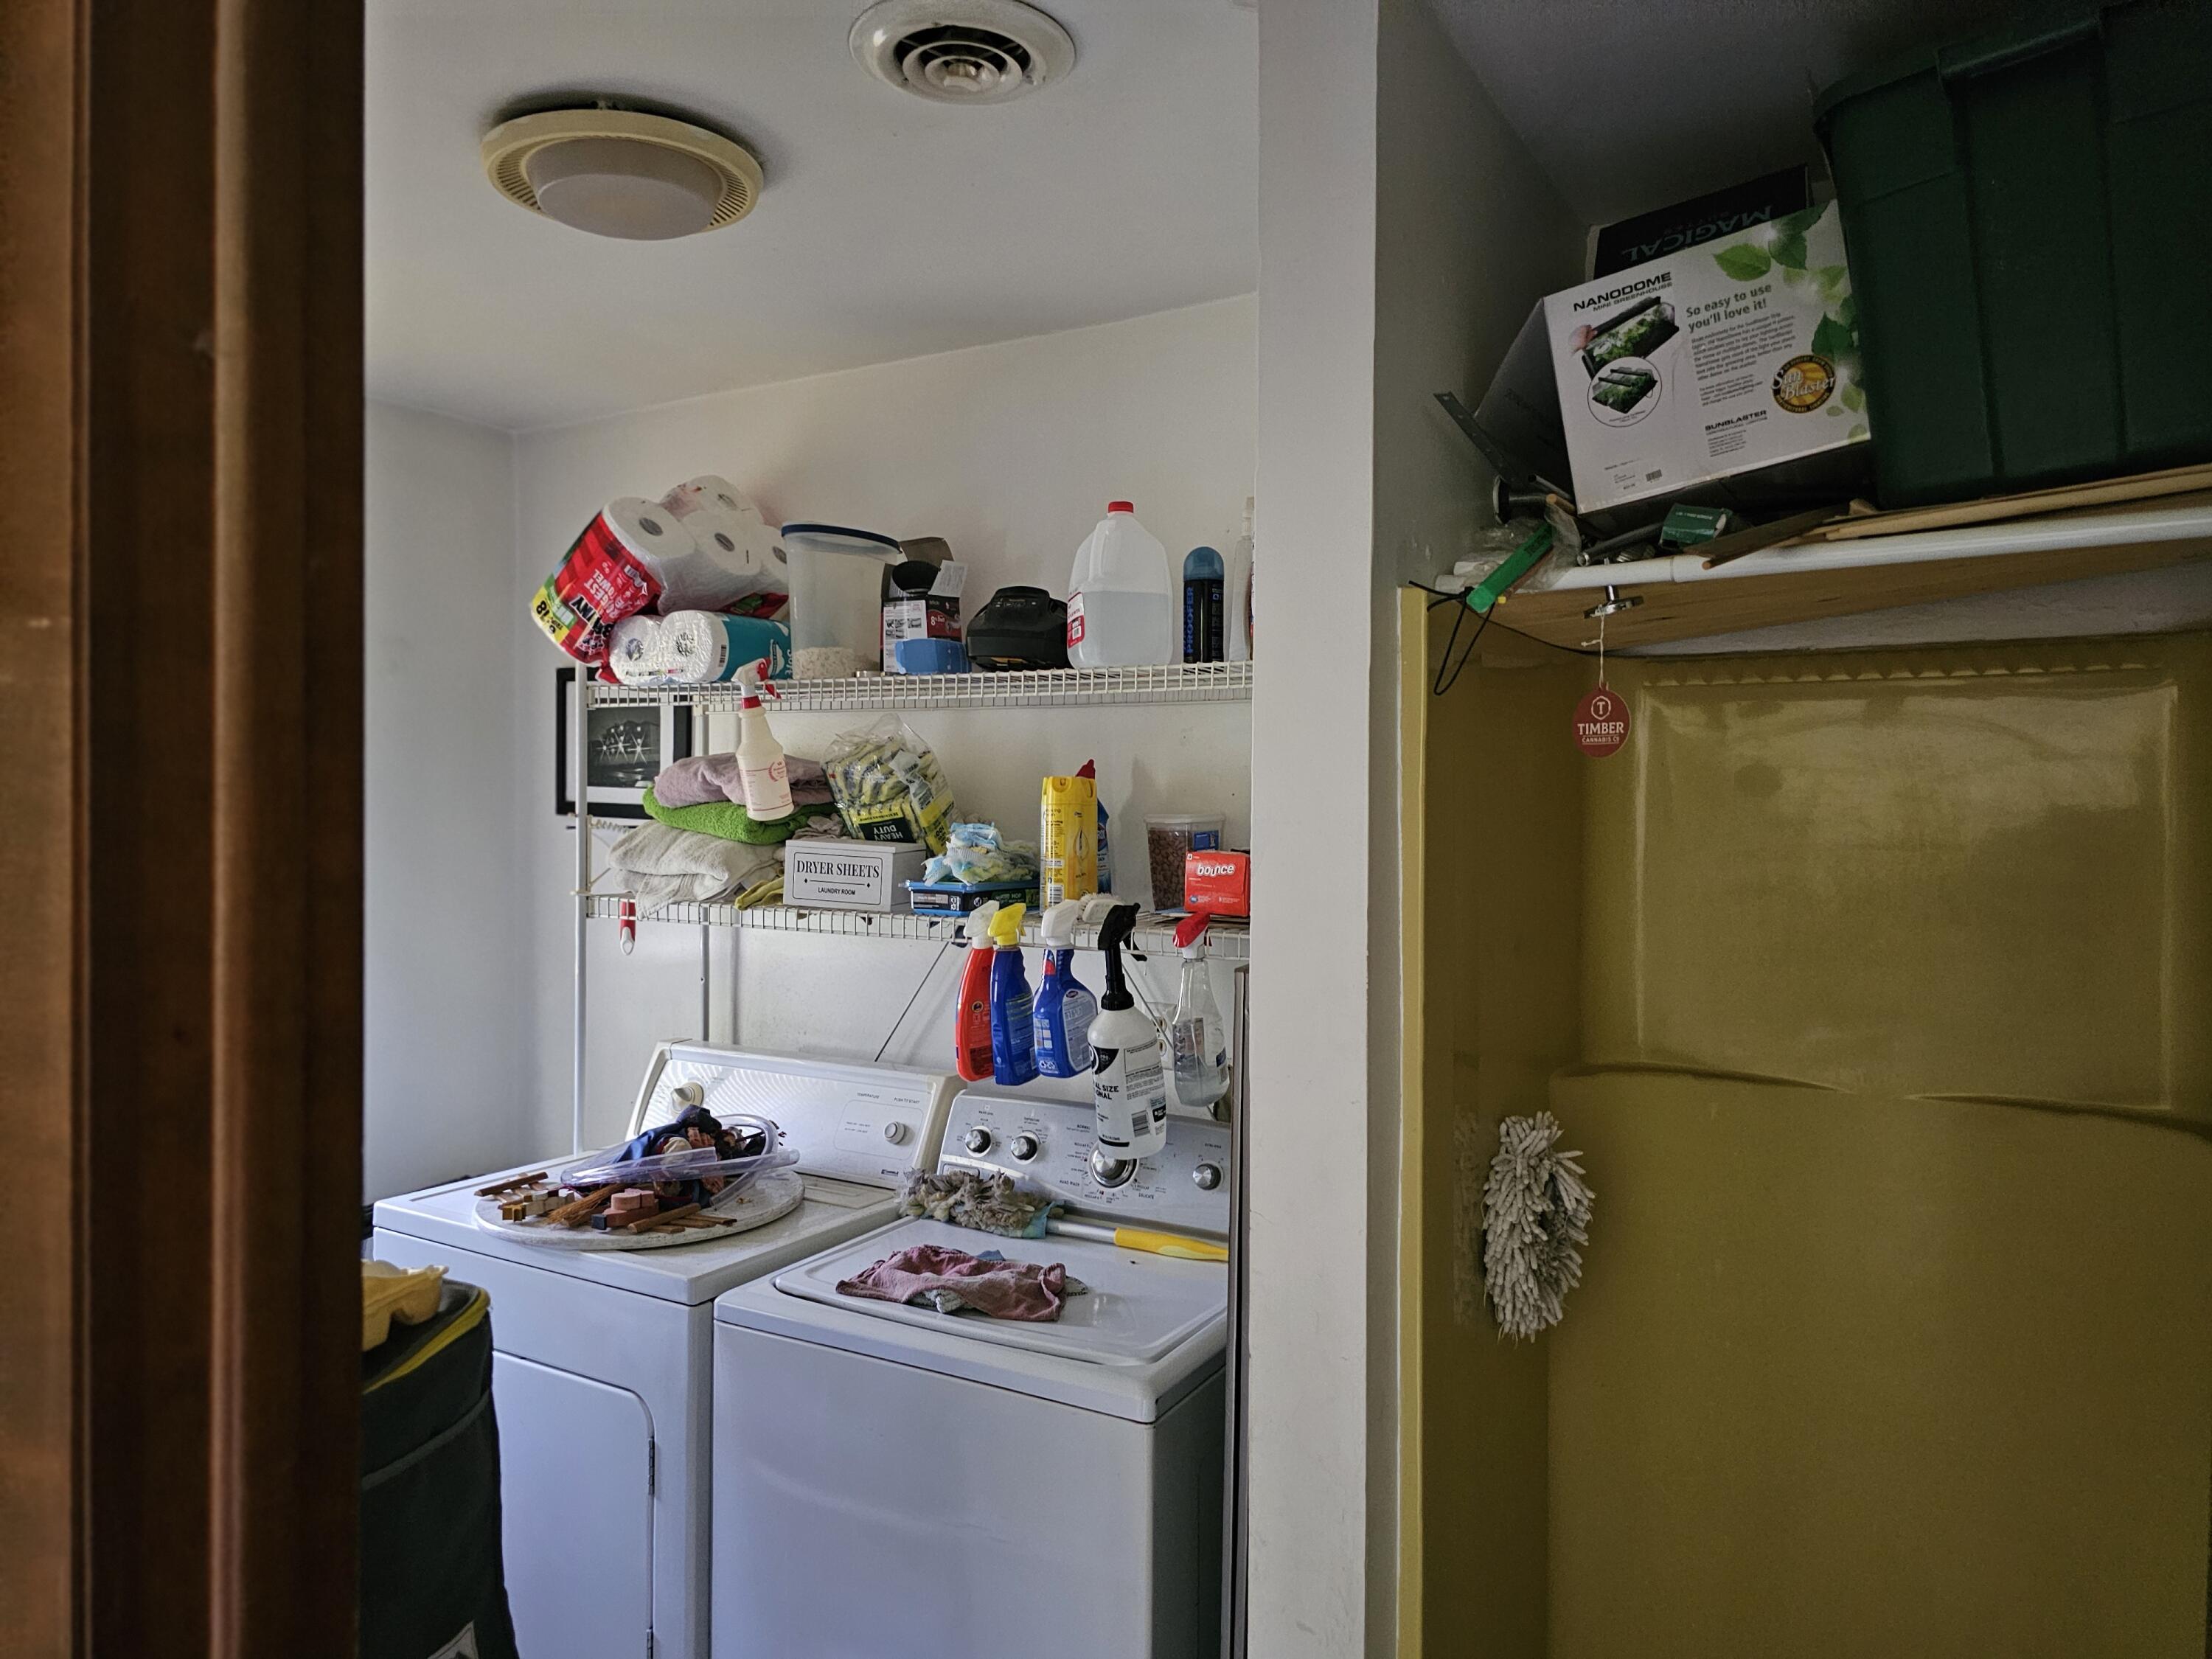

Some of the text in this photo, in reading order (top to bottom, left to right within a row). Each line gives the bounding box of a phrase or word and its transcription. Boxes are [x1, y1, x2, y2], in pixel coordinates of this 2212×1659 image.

[1621, 206, 1772, 262] MAGICAL
[1573, 271, 1672, 312] NANODOME
[1593, 301, 1611, 312] MINI
[1686, 284, 1772, 318] So easy to use
[1688, 299, 1767, 333] you'll love it!
[1771, 369, 1803, 390] Sun
[1781, 375, 1836, 400] Blaster
[1705, 410, 1767, 431] SUNBLASTER
[536, 600, 550, 617] 18
[1186, 586, 1194, 655] PROOFER
[1596, 700, 1606, 714] T
[1577, 721, 1624, 735] TIMBER
[872, 824, 897, 834] DUTY
[873, 832, 903, 841] HEAVY
[796, 860, 880, 878] DRYER SHEETS
[1197, 863, 1235, 877] bounce
[818, 886, 841, 894] LAUNDRY
[1102, 1085, 1119, 1093] SIZE
